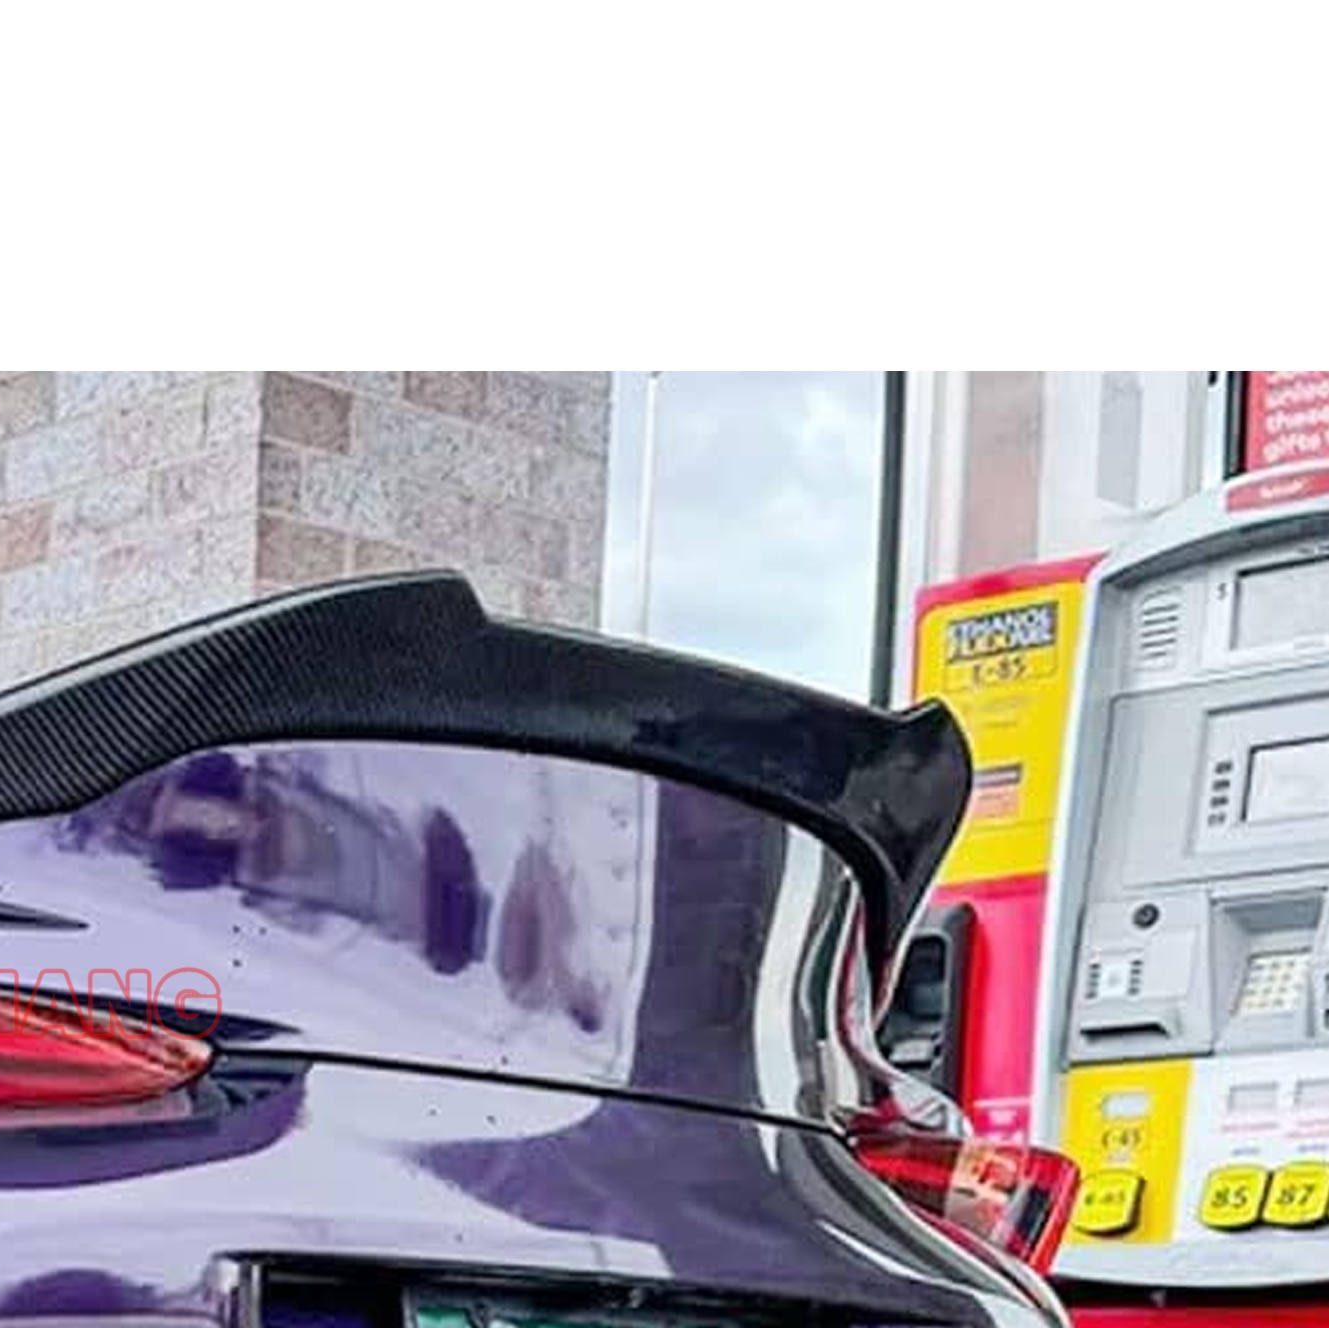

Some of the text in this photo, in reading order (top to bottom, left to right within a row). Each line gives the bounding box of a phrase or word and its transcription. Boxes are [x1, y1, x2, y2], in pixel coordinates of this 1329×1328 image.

[973, 656, 1027, 687] E-85
[1212, 1184, 1249, 1210] 85
[1275, 1182, 1317, 1206] 87
